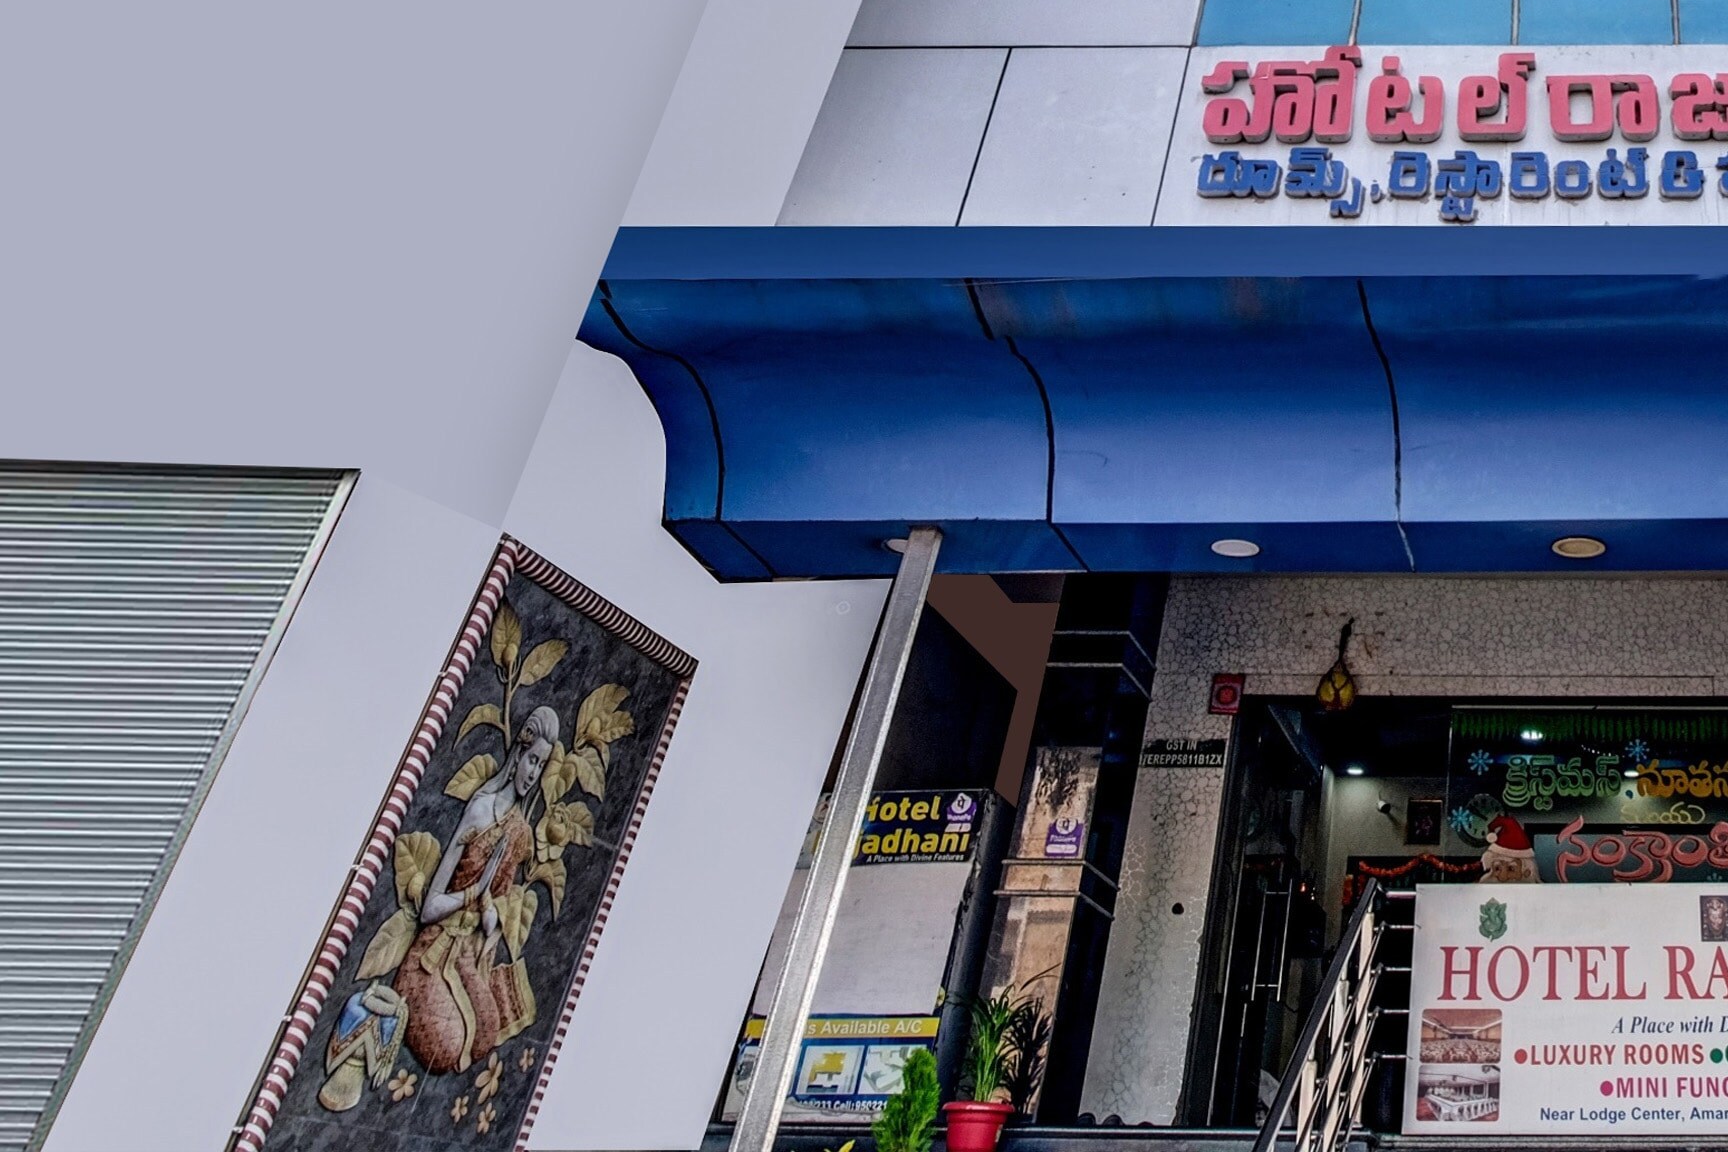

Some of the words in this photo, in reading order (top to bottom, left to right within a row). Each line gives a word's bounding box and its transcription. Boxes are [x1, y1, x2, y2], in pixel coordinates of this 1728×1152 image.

[1436, 945, 1647, 1002] HOTEL
[820, 1019, 890, 1035] Available
[894, 1019, 922, 1035] A/C
[1611, 1017, 1623, 1034] A
[1630, 1016, 1675, 1034] Place
[1680, 1015, 1714, 1034] with
[1530, 1044, 1616, 1066] LUXURY
[1624, 1043, 1705, 1066] ROOMS
[1616, 1076, 1667, 1099] MINI
[1540, 1107, 1575, 1121] Near
[1579, 1107, 1627, 1125] Lodge
[1630, 1106, 1685, 1122] Center,
